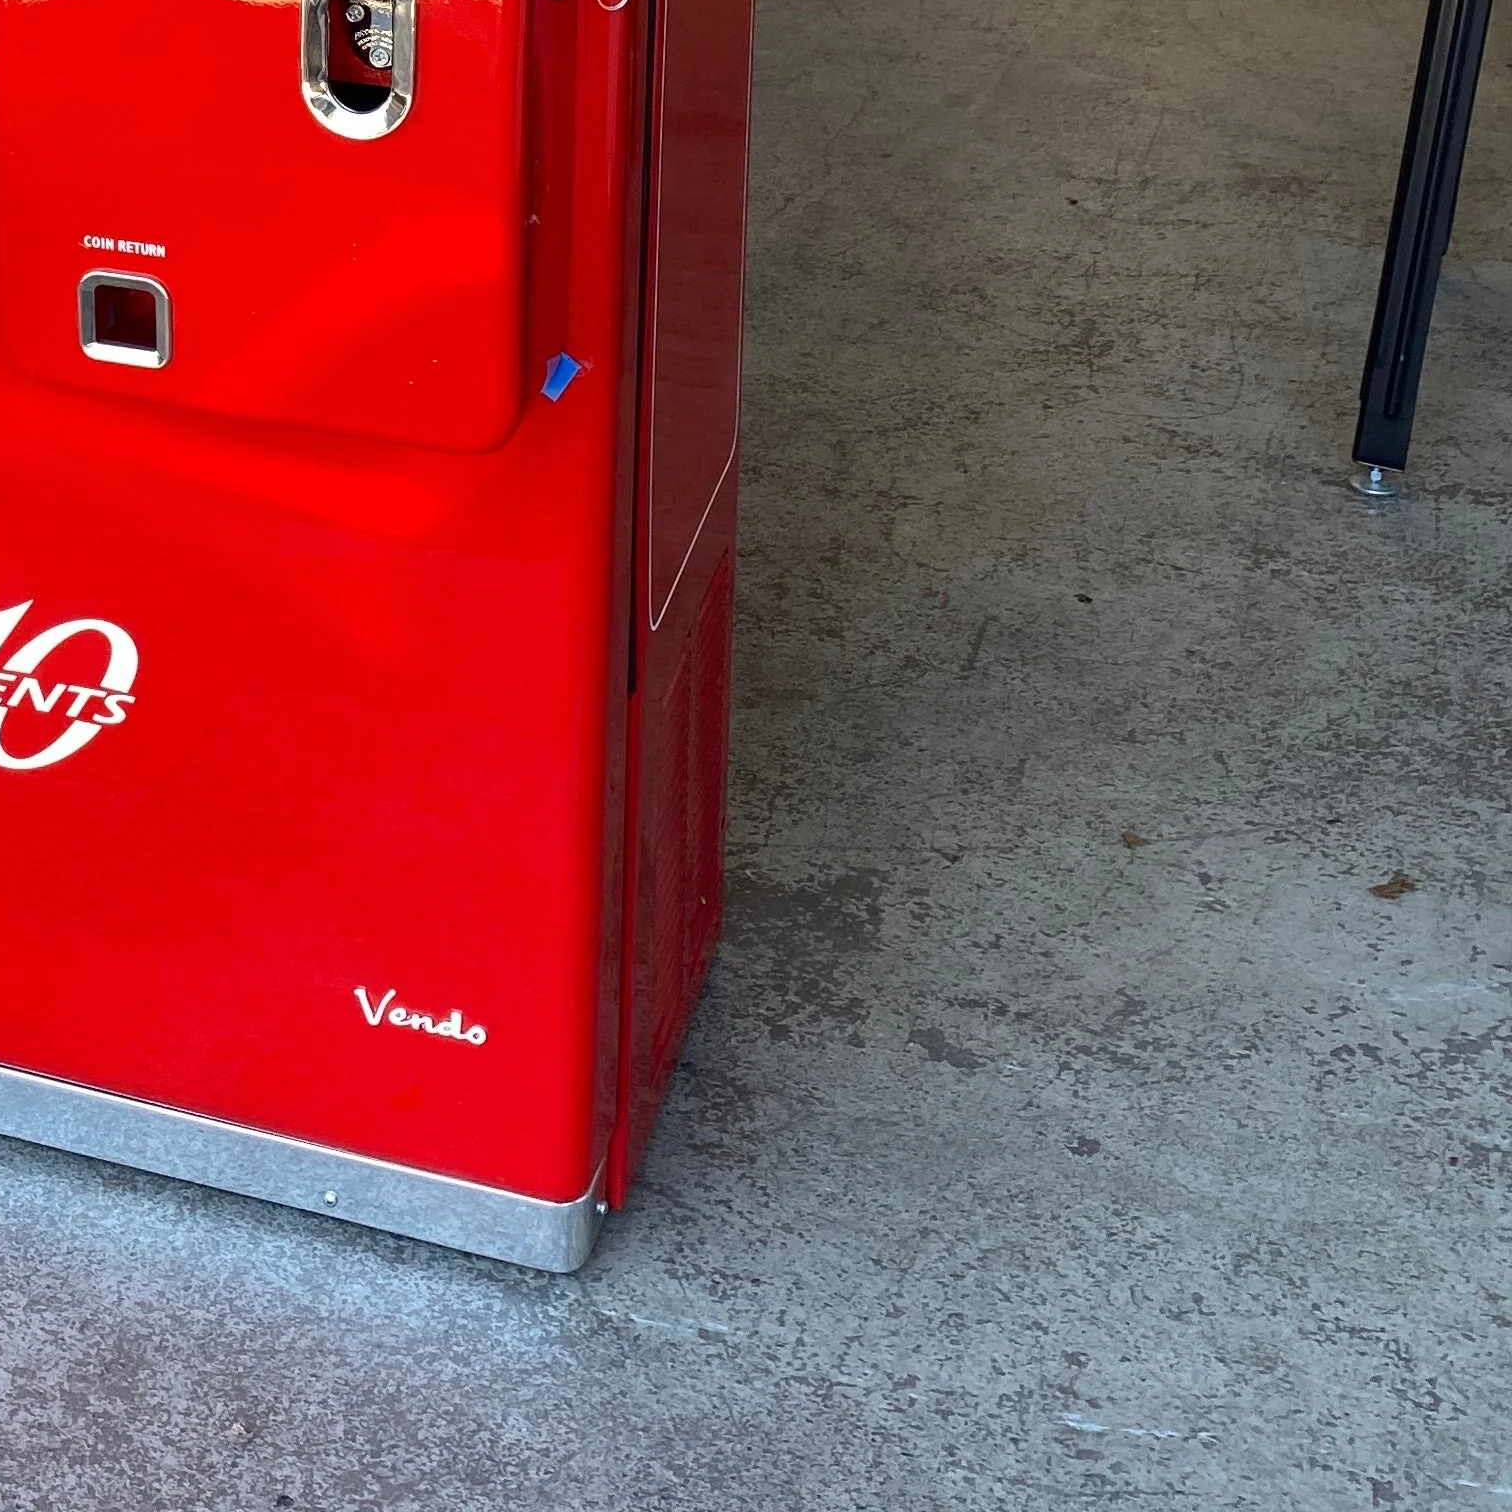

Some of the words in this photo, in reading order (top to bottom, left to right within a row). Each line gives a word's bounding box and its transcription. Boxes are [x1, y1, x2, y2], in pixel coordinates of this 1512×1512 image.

[83, 234, 115, 251] COIN
[117, 239, 166, 258] RETURN
[353, 985, 488, 1046] Vendo
